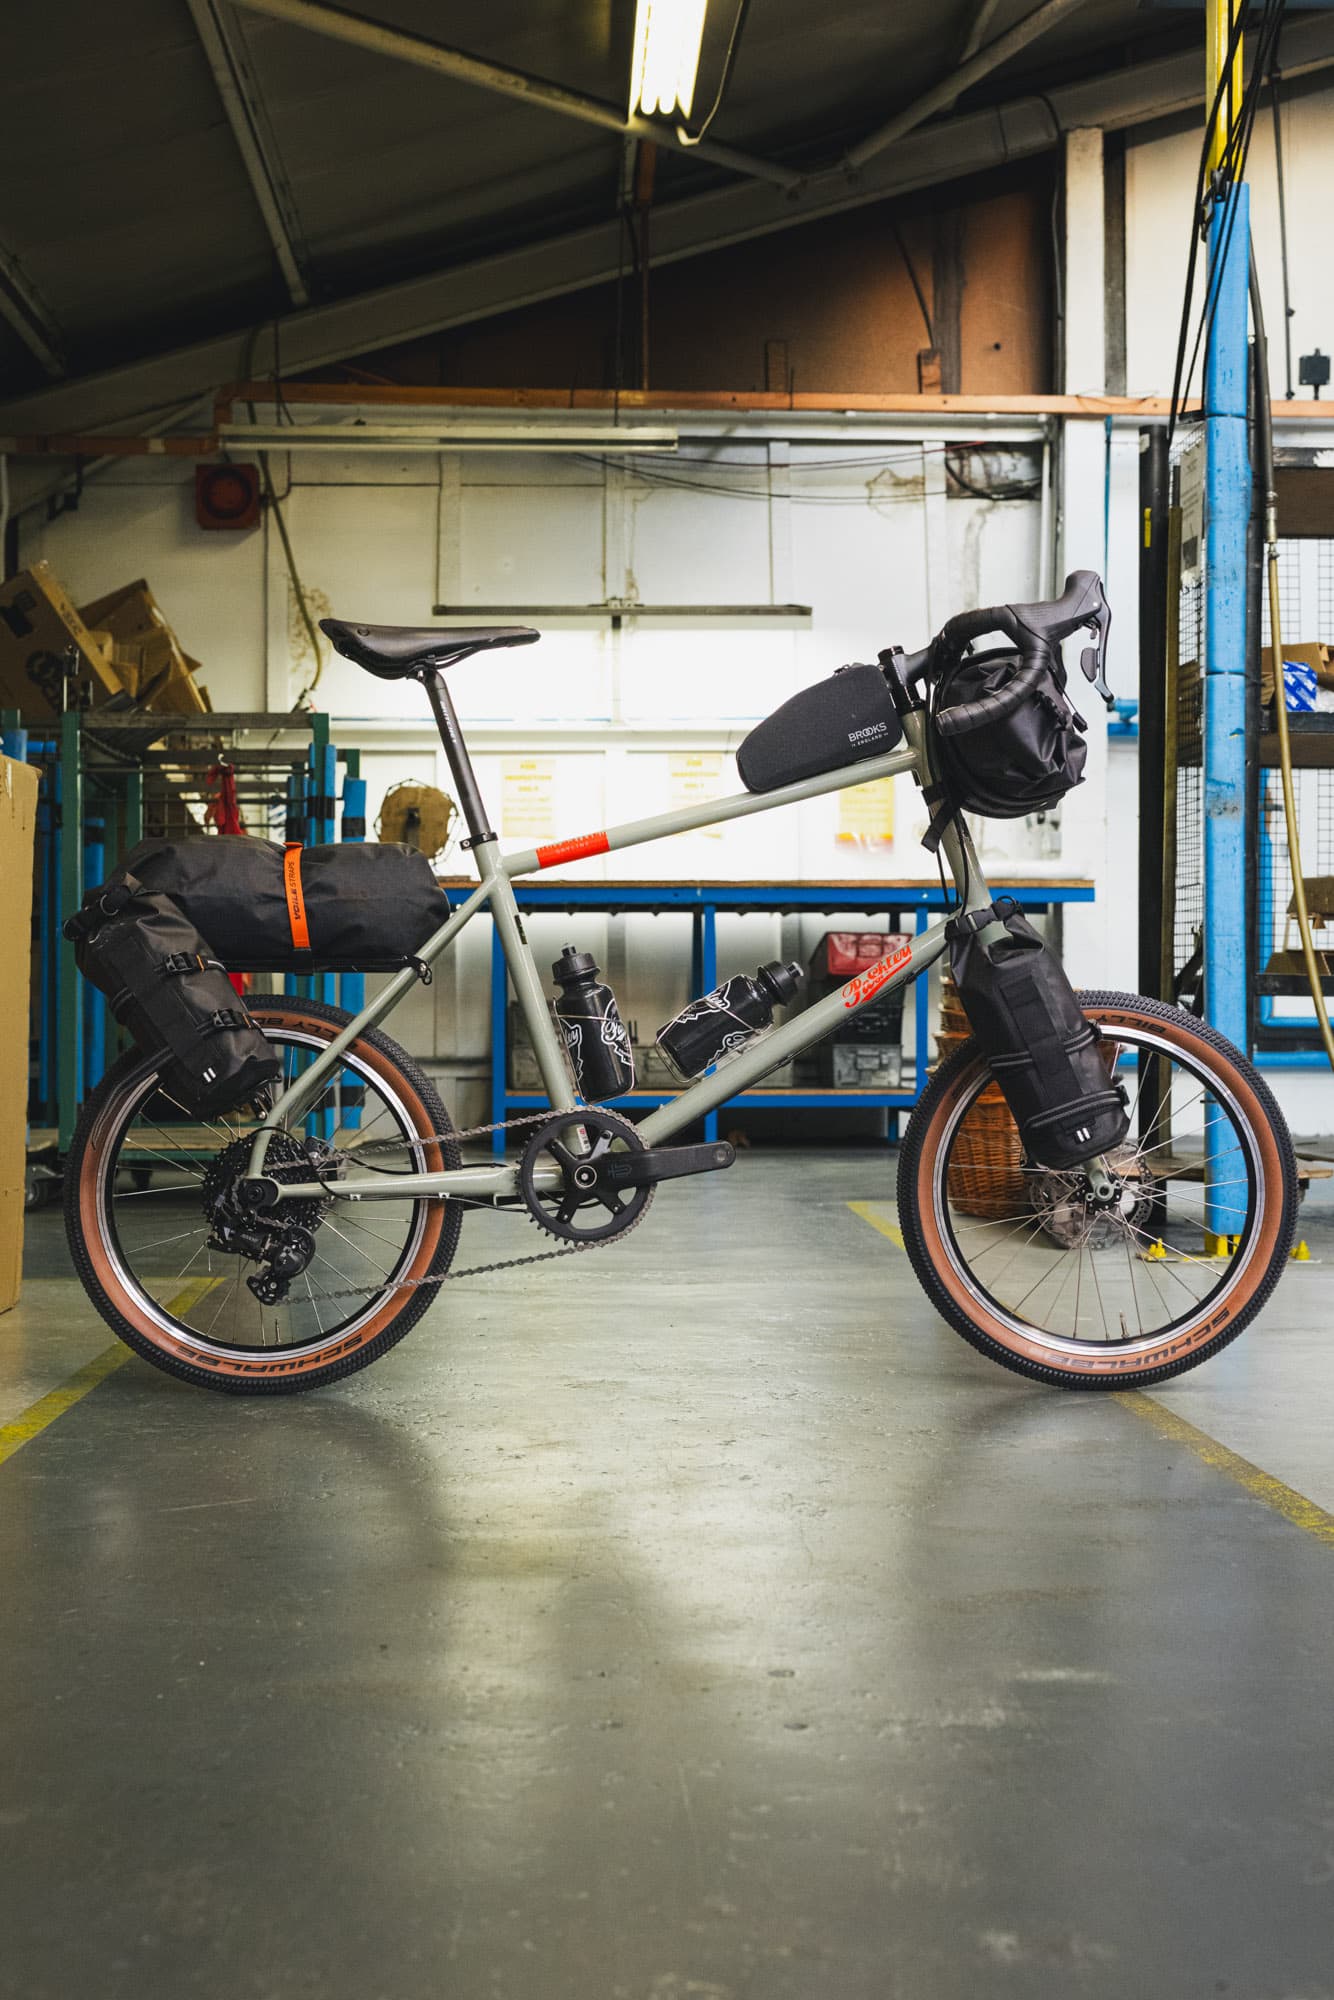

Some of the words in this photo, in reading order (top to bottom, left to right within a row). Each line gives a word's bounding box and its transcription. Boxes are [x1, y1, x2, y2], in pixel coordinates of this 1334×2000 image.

[848, 722, 887, 742] BROOKS
[1097, 1015, 1167, 1034] BILLY
[1047, 1307, 1228, 1368] SCHWALBE
[175, 1334, 362, 1373] SCHWALBE
